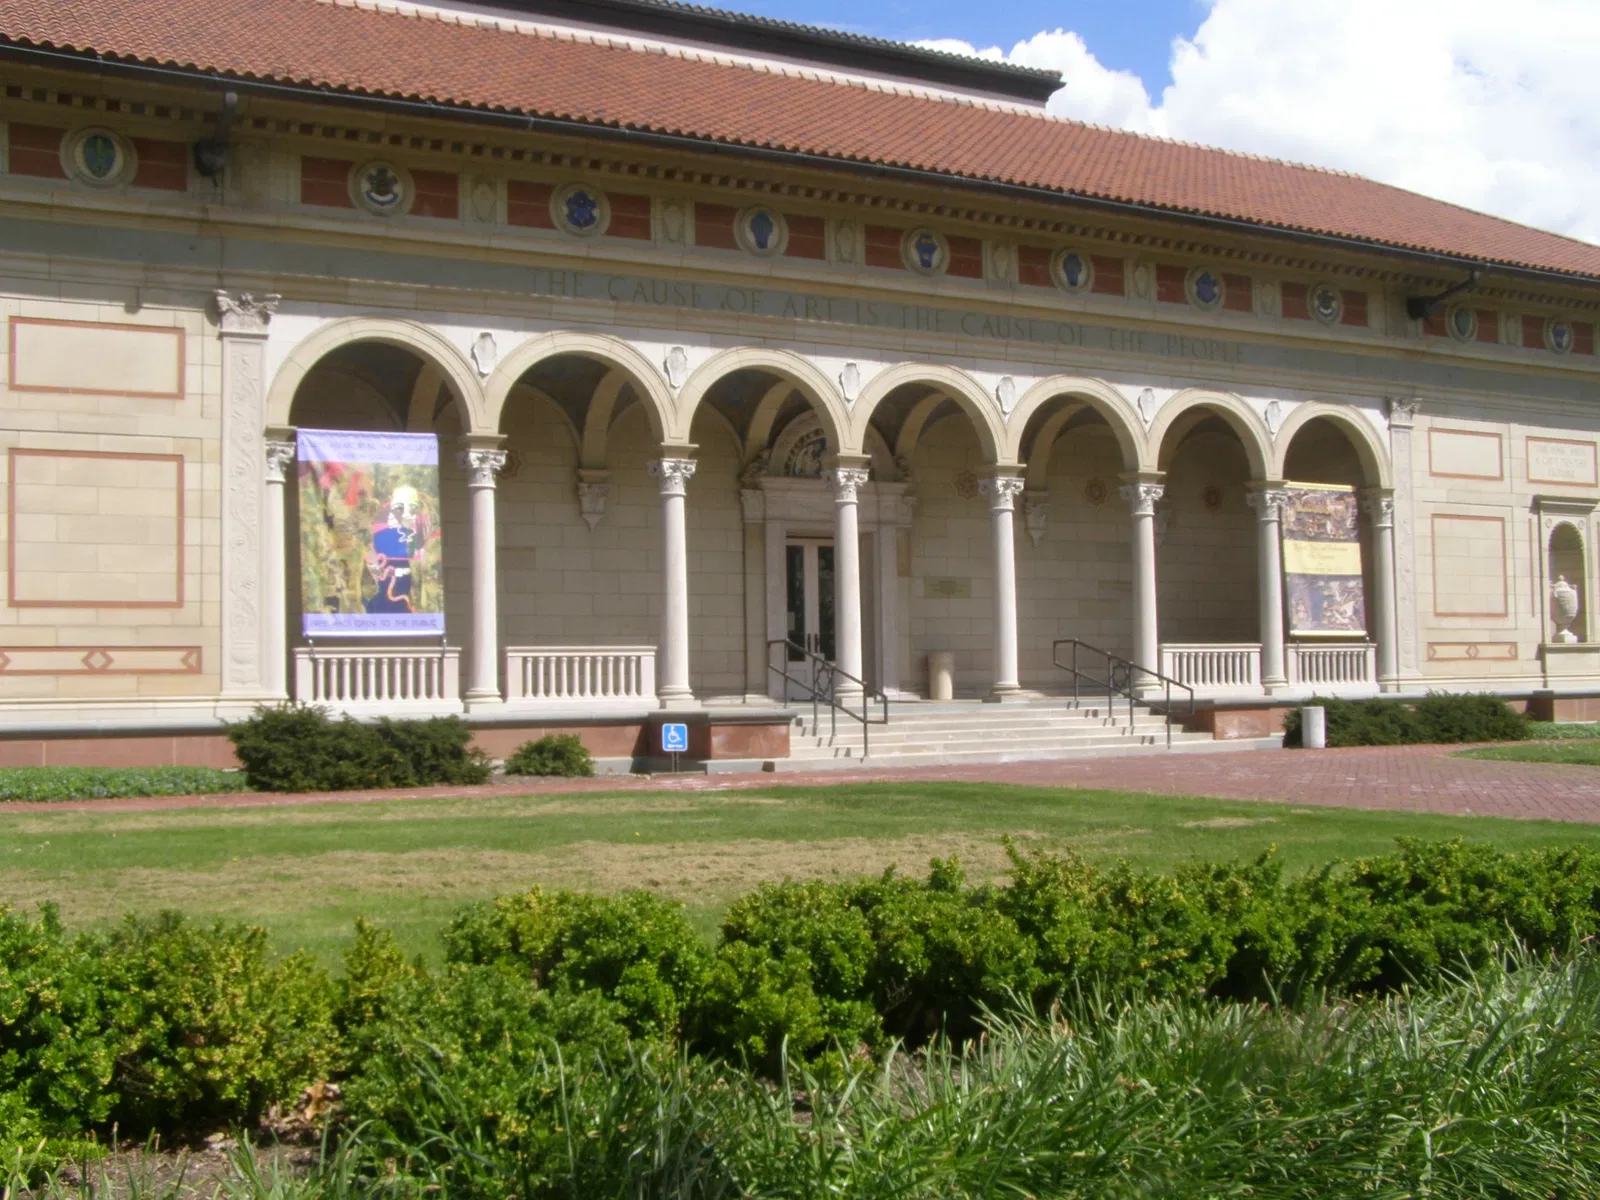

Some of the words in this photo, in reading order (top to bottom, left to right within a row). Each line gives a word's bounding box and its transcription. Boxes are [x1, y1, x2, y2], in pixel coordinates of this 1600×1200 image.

[532, 270, 586, 298] THE
[607, 274, 704, 307] CAUSE
[726, 287, 762, 313] OF
[782, 294, 837, 321] ART
[854, 298, 879, 325] IS
[898, 305, 945, 332] THE
[960, 311, 1039, 341] CAUSE
[1056, 322, 1089, 346] OF
[1103, 325, 1147, 353] THE
[1165, 332, 1247, 363] PEOPLE
